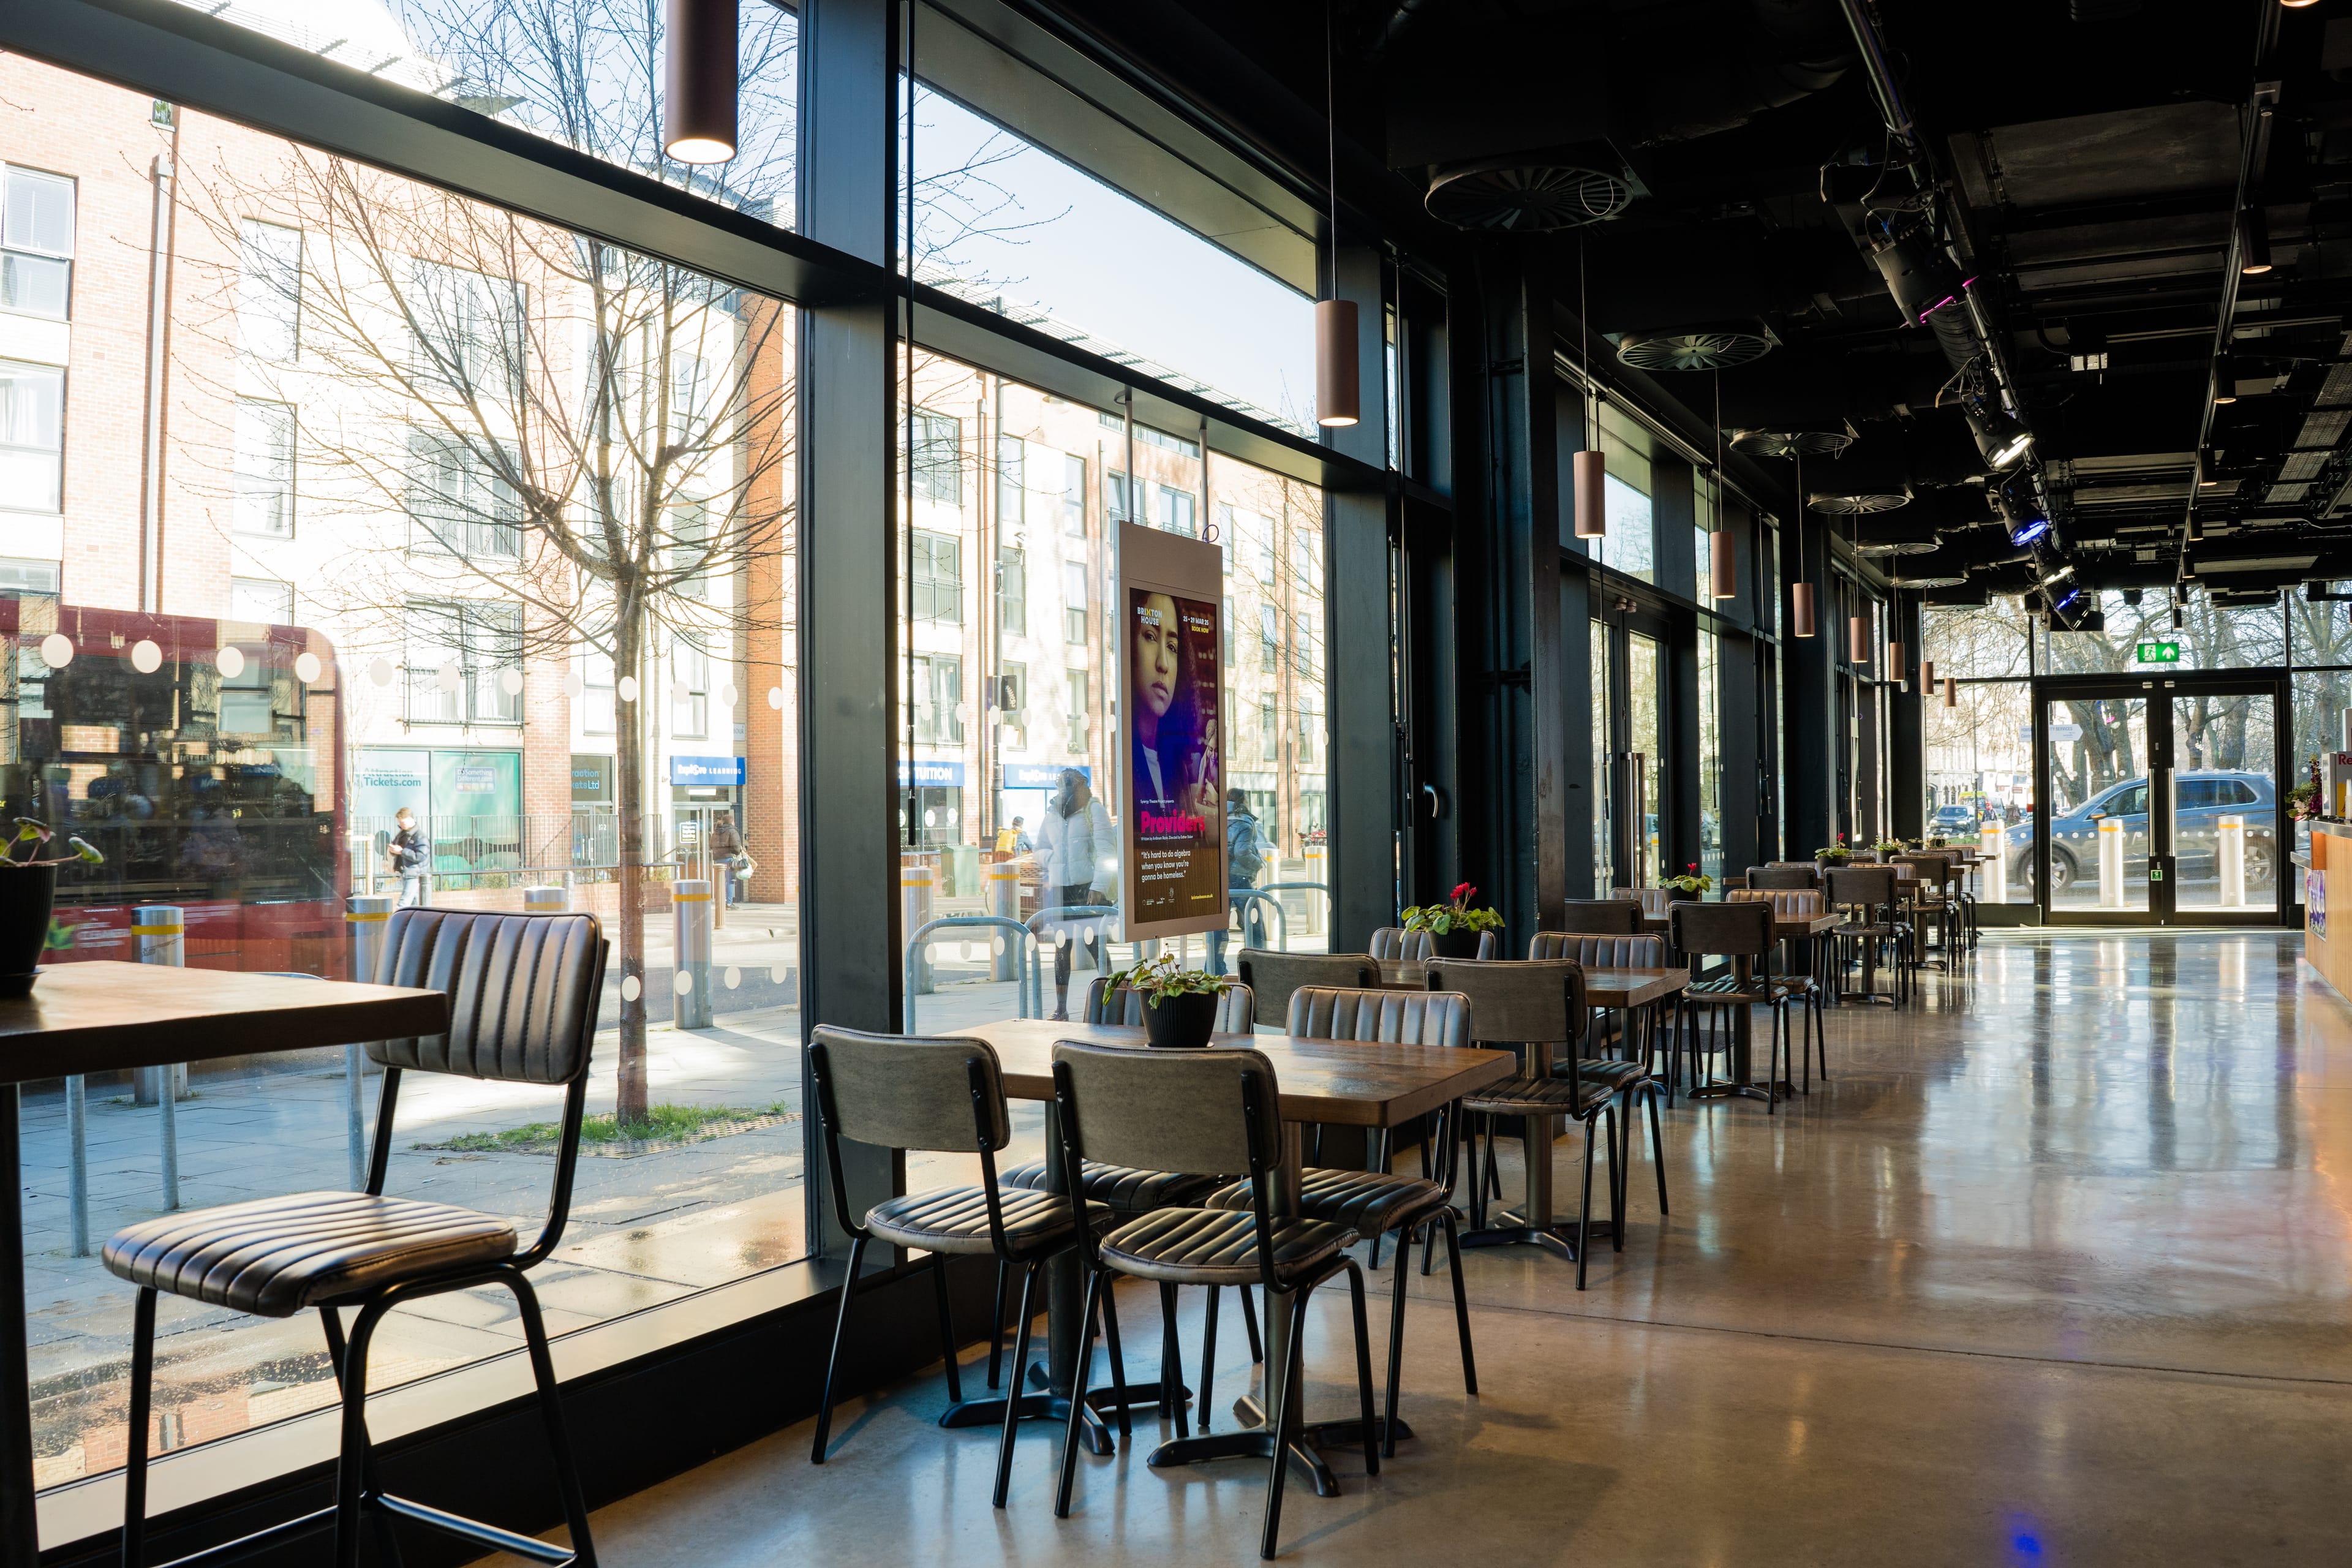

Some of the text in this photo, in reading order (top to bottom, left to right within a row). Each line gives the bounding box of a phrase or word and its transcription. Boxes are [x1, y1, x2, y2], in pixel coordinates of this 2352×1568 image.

[1137, 606, 1163, 618] BRIXTON
[1141, 616, 1159, 626] HOUSE
[2338, 754, 2352, 765] Re
[914, 767, 952, 780] TUITION
[364, 777, 421, 786] Tickets.com
[1141, 809, 1205, 834] Providers
[1174, 849, 1191, 858] algebra
[1176, 860, 1189, 870] you're
[1142, 874, 1156, 883] gonna
